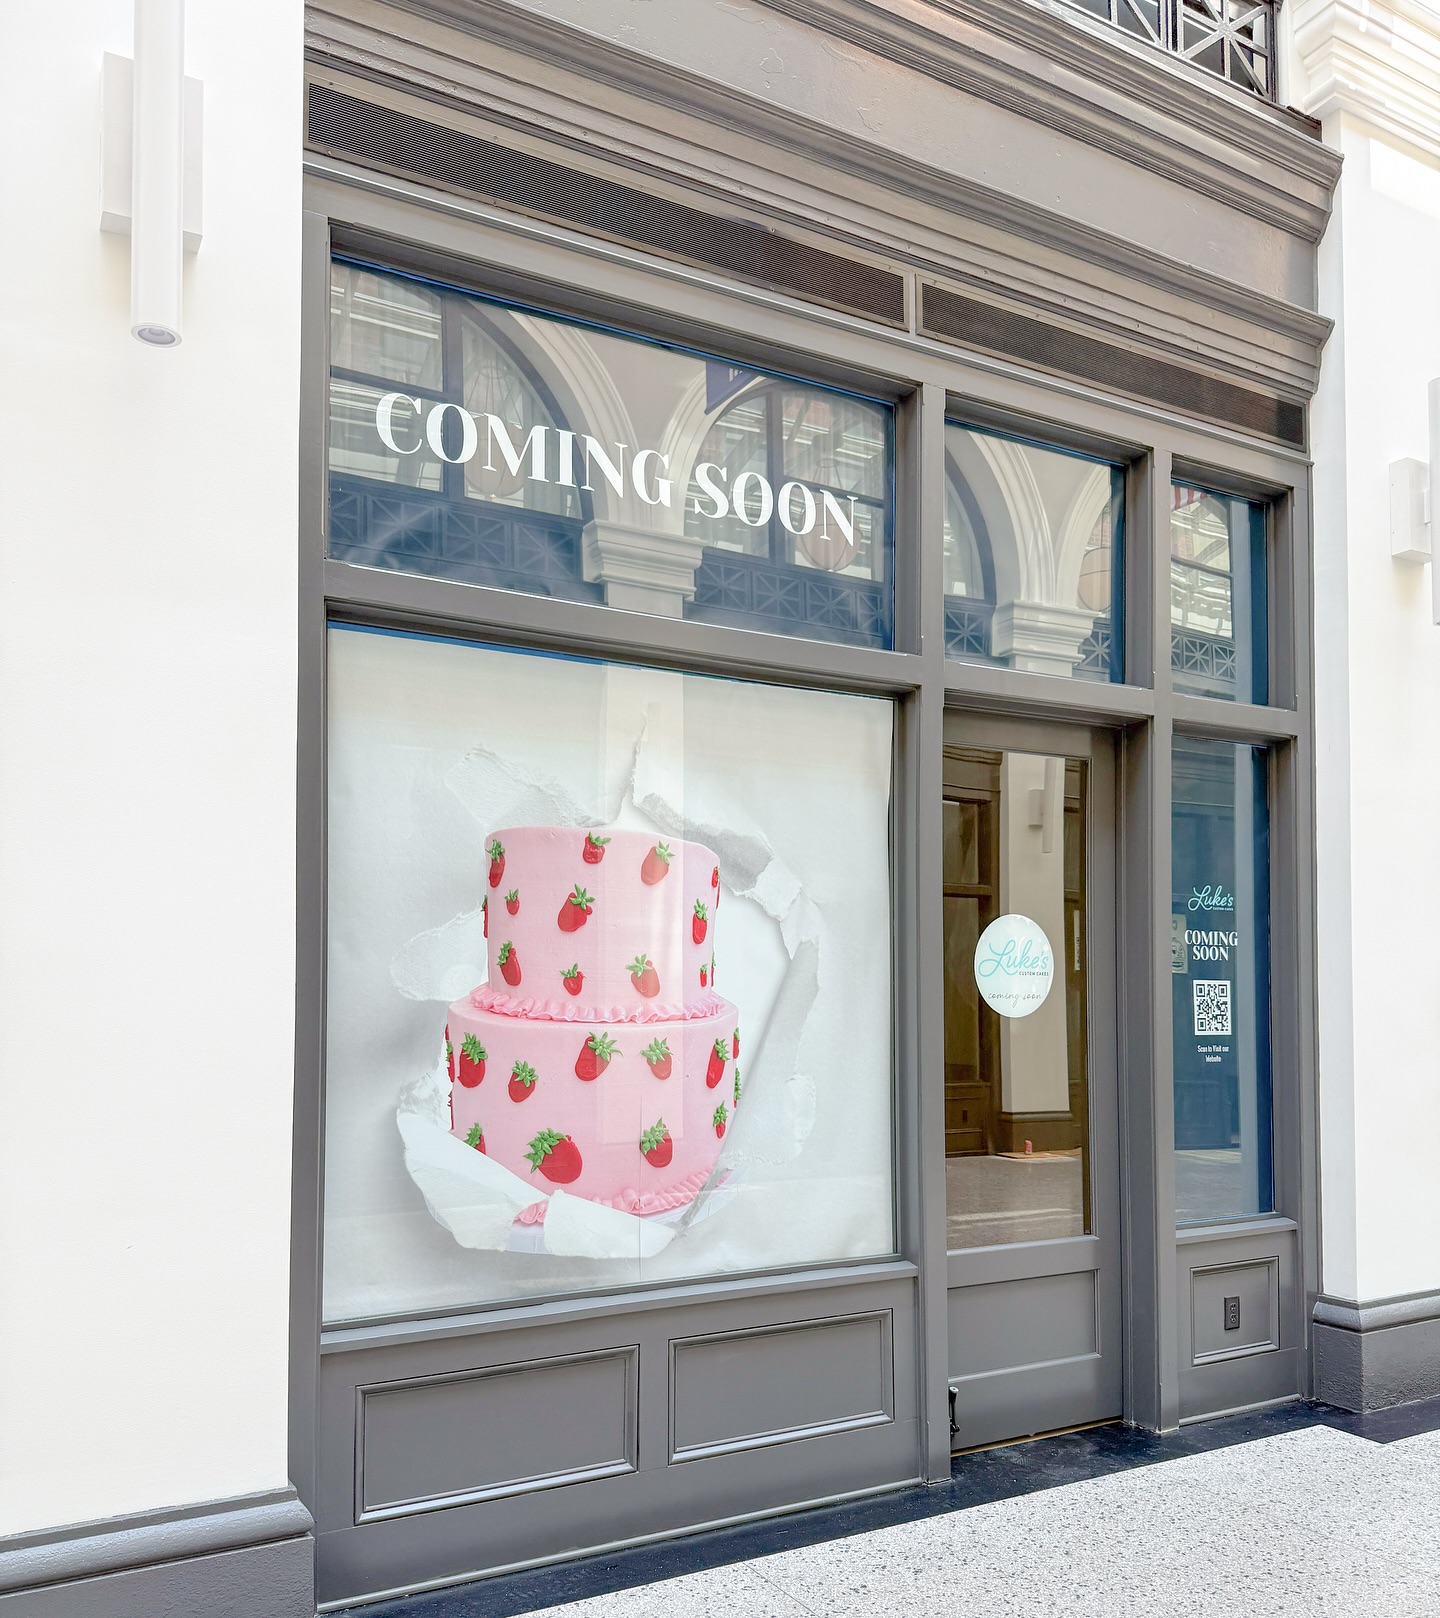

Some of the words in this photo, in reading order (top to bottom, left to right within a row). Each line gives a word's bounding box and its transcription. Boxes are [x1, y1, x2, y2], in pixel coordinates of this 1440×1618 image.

[375, 392, 674, 508] COMING
[694, 462, 859, 547] SOON
[1188, 885, 1234, 911] Luke's
[1184, 929, 1238, 947] COMING
[978, 939, 1049, 977] Luke's
[1192, 945, 1230, 961] SOON
[988, 993, 1020, 1008] coming
[1205, 1055, 1222, 1063] Website
